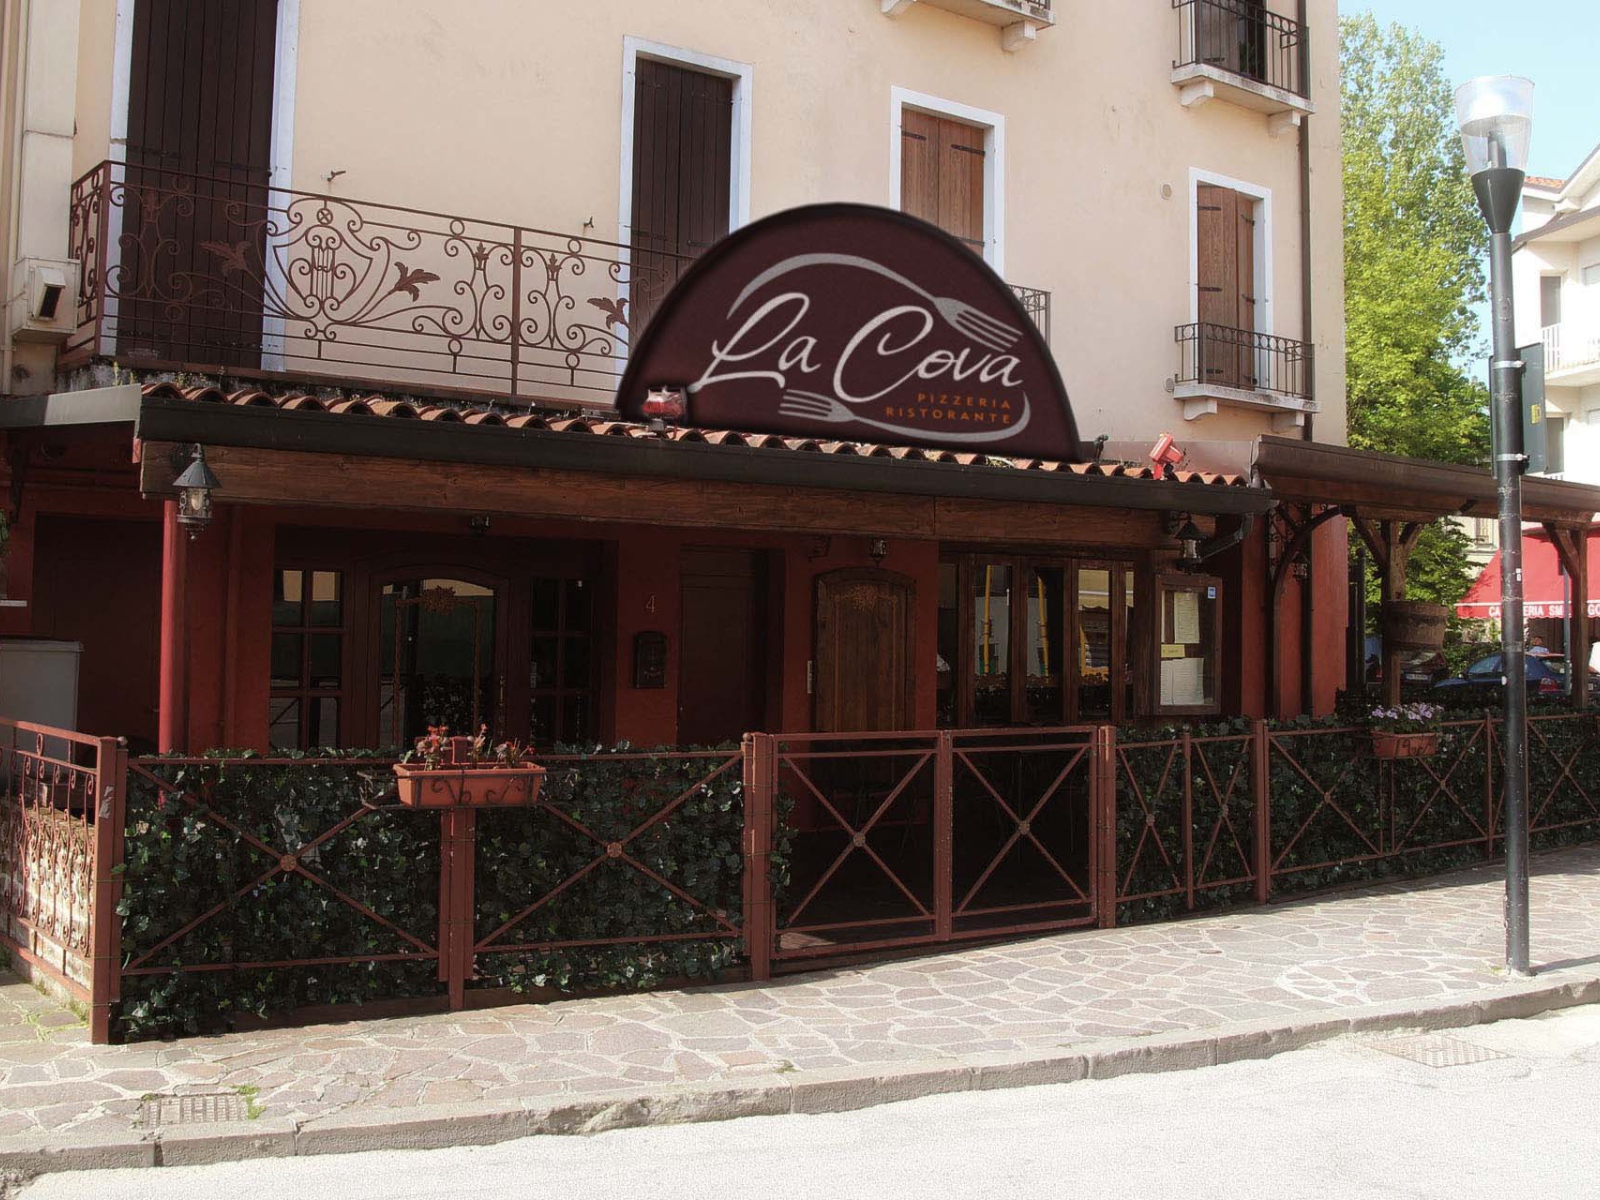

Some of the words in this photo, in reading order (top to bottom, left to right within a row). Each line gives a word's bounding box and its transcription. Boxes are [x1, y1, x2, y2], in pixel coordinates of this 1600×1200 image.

[688, 291, 822, 394] La
[832, 304, 1024, 404] Cova
[917, 393, 1011, 409] PIZZERIA
[885, 406, 1011, 424] RISTORANTE
[645, 595, 656, 613] 4
